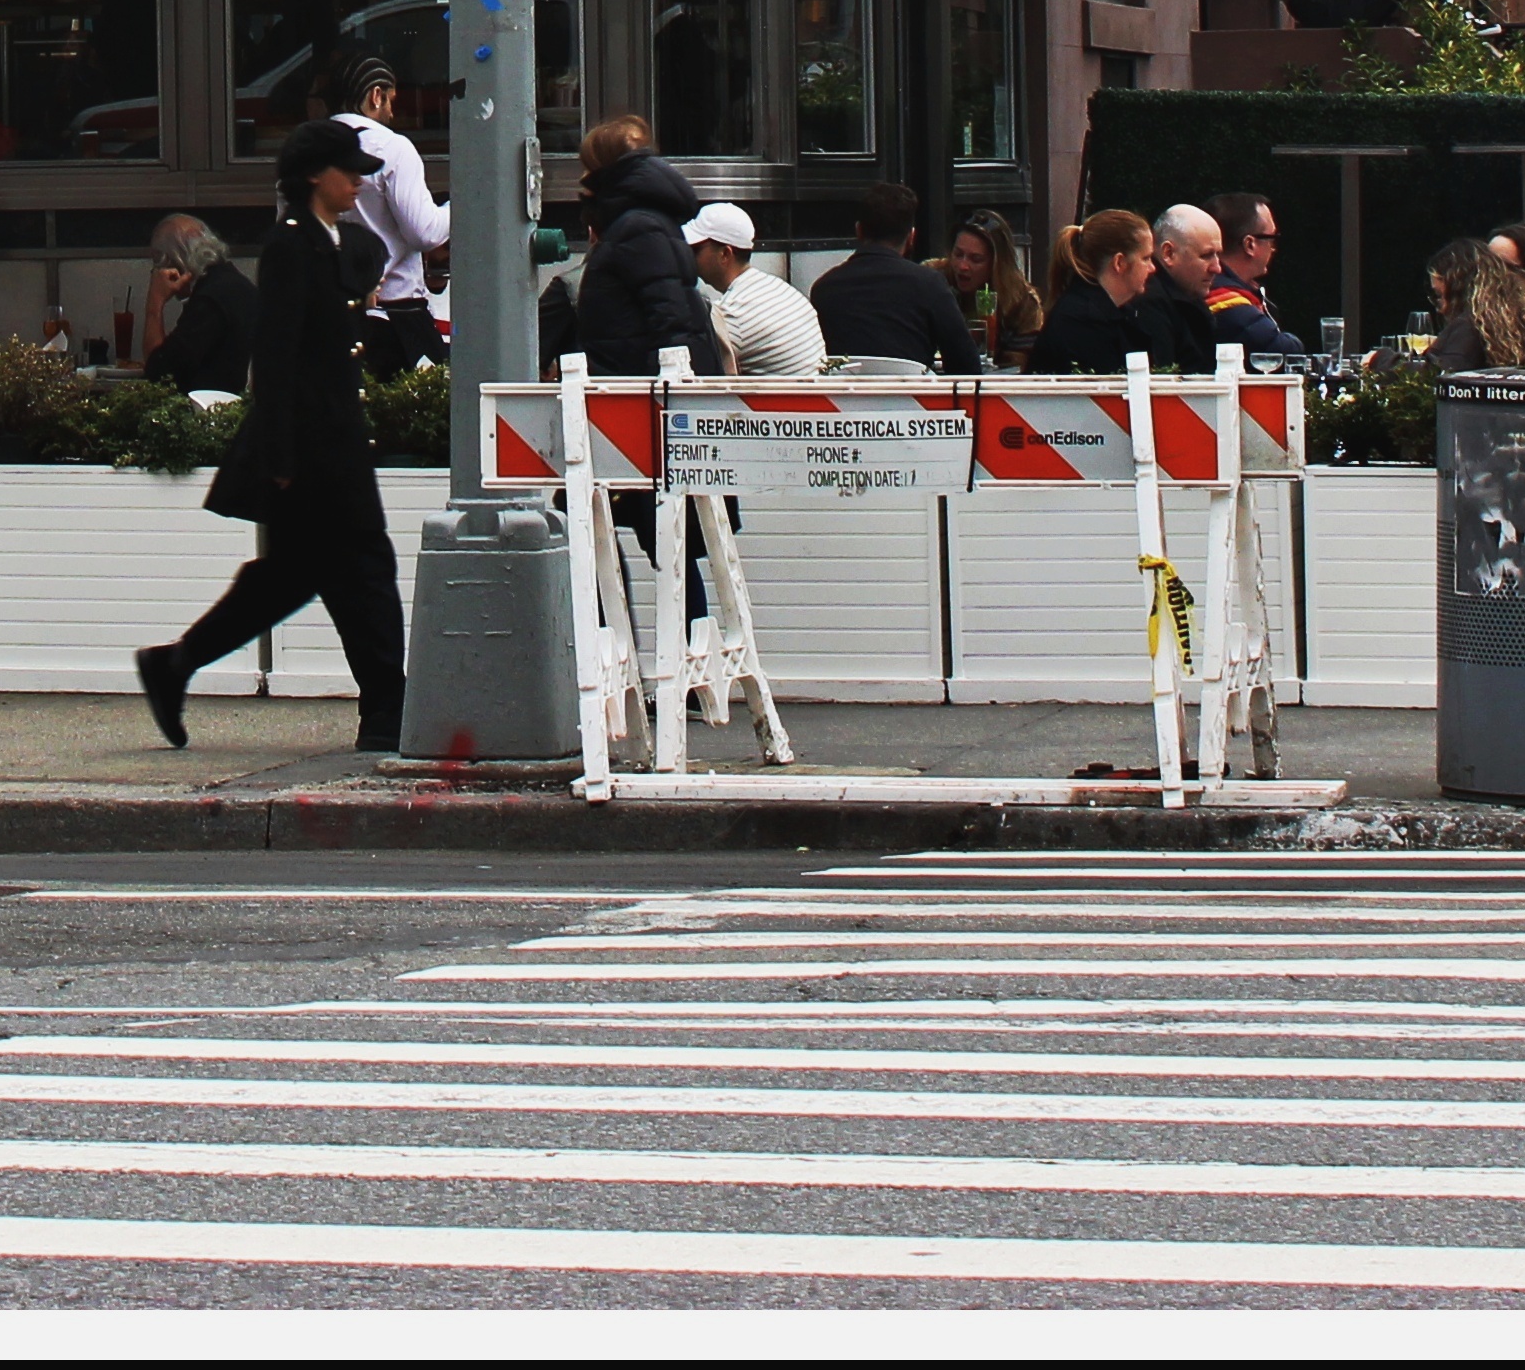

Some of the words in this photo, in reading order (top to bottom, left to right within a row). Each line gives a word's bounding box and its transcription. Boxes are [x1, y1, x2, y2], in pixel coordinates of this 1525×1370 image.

[1448, 385, 1480, 399] Don't
[696, 418, 770, 438] REPAIRING
[774, 419, 813, 438] YOUR
[816, 419, 905, 438] ELECTRICAL
[908, 418, 966, 437] SYSTEM
[1027, 431, 1105, 446] conEdison
[667, 444, 709, 462] PERMIT
[807, 446, 850, 464] PHONE
[667, 468, 703, 486] START
[705, 468, 738, 487] DATE:
[808, 470, 872, 489] COMPLETION
[874, 469, 904, 488] DATE:
